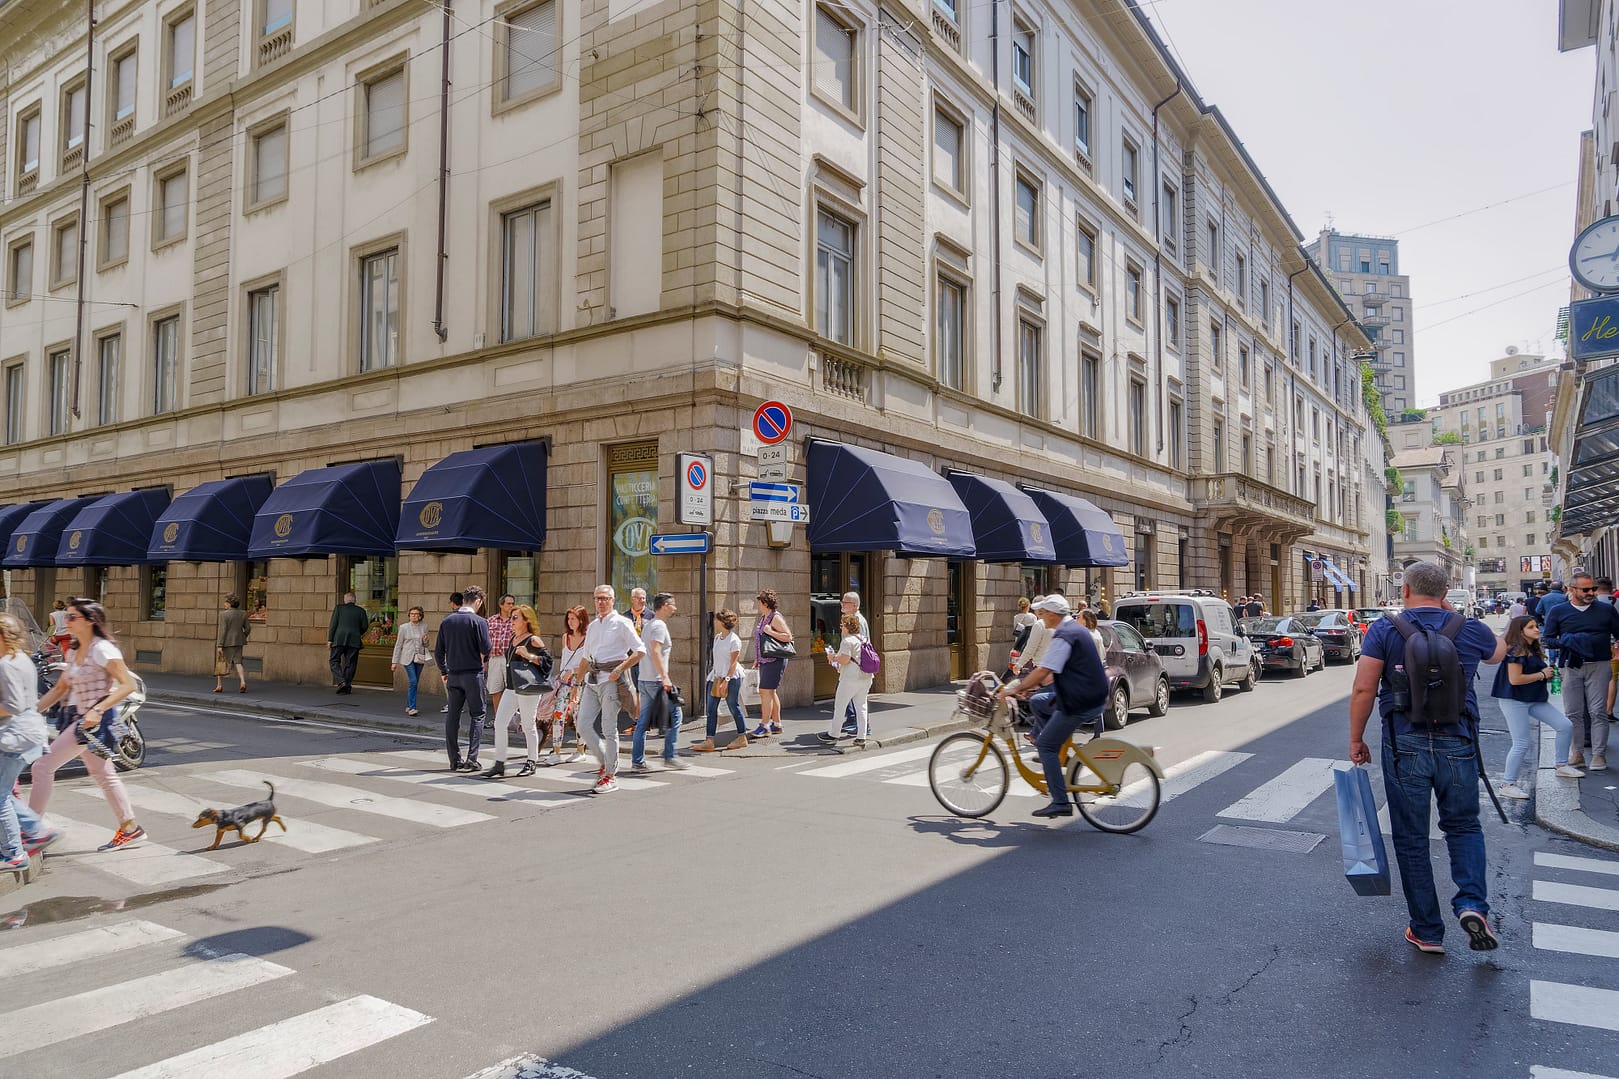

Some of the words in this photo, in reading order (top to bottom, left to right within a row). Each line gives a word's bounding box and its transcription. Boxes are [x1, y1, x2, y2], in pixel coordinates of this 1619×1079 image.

[1581, 315, 1619, 341] He
[752, 506, 769, 515] piazza
[770, 506, 787, 516] meda
